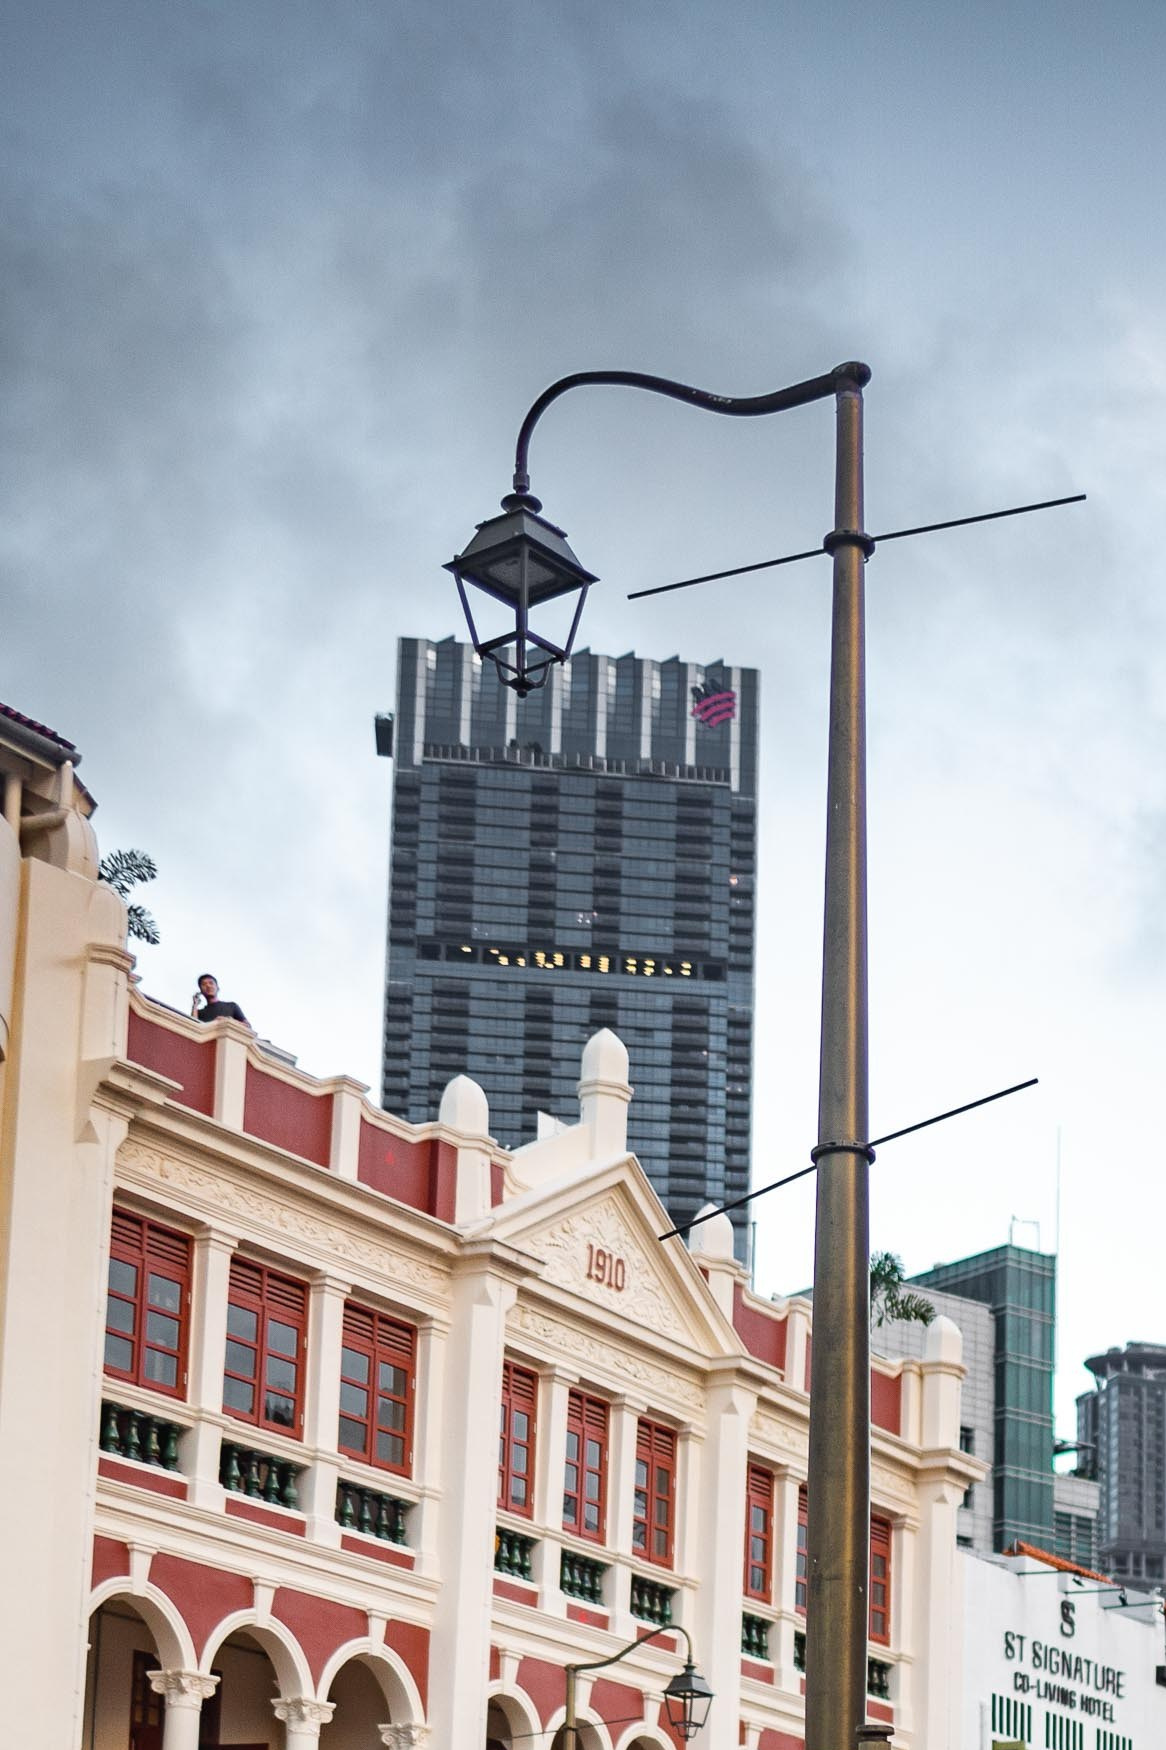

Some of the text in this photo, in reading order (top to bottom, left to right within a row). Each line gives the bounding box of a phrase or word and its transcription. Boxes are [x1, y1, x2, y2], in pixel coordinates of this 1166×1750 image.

[586, 1243, 625, 1292] 1910
[1004, 1631, 1126, 1699] ST SIGNATURE
[1014, 1671, 1115, 1723] CO-LIVING HOTEL
